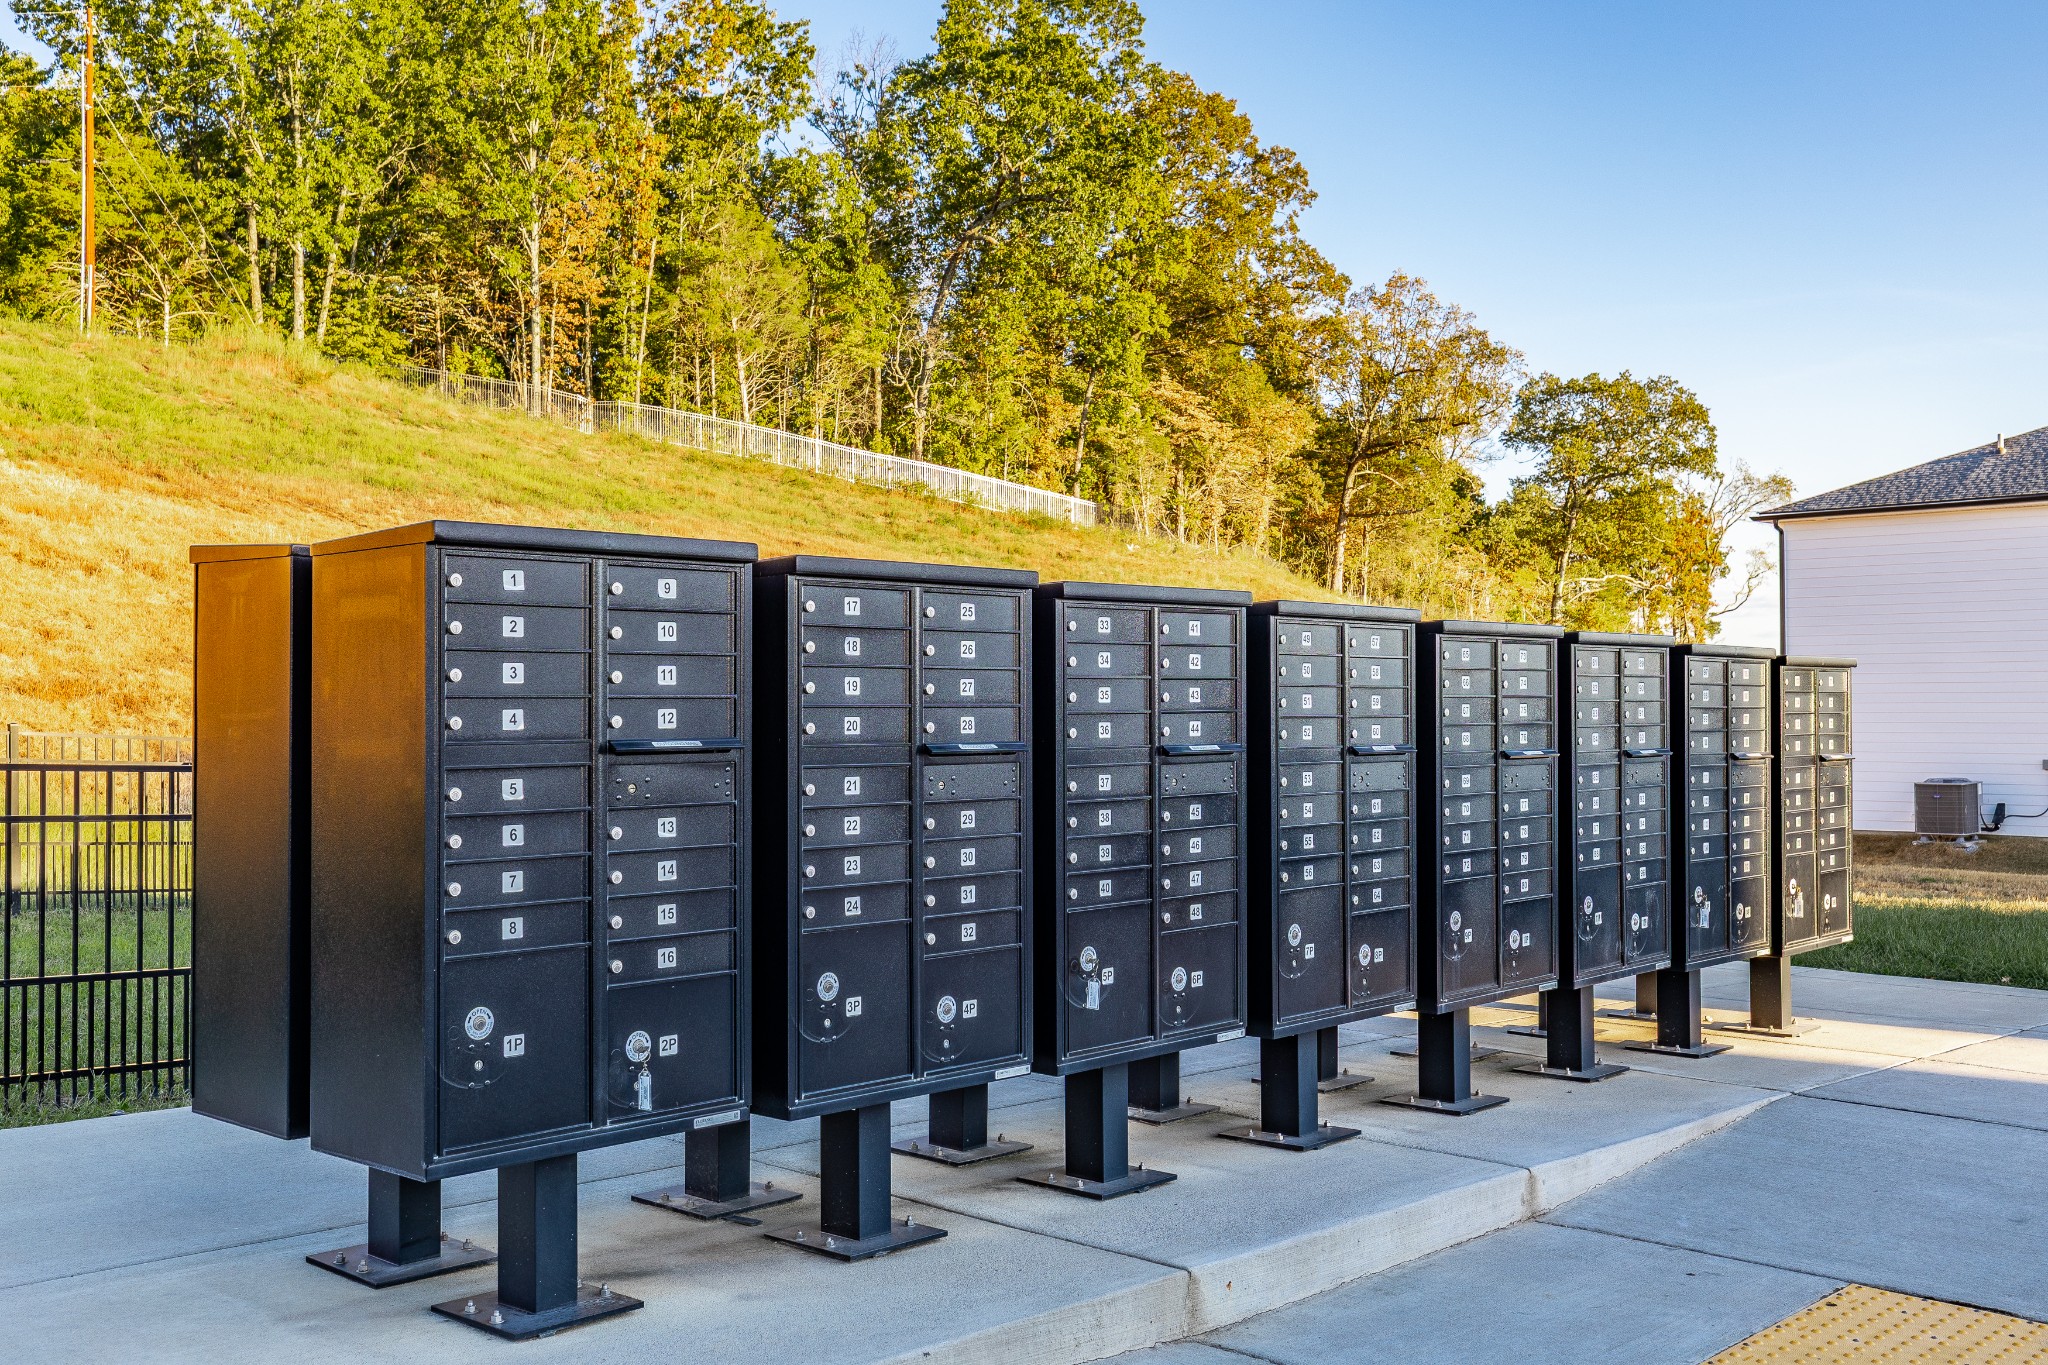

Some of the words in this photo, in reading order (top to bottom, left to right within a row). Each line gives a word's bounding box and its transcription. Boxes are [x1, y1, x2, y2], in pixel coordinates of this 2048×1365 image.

[511, 574, 516, 586] 1
[664, 582, 670, 594] 9
[847, 601, 858, 611] 17
[962, 606, 973, 617] 25
[510, 620, 517, 633] 2
[1100, 620, 1108, 630] 33
[1190, 624, 1198, 633] 41
[661, 625, 674, 637] 10
[1303, 634, 1310, 644] 49
[1371, 638, 1379, 647] 57
[847, 640, 857, 652] 18
[962, 644, 973, 655] 26
[1100, 655, 1109, 665] 34
[1191, 657, 1199, 667] 42
[510, 667, 517, 679] 3
[661, 669, 673, 681] 11
[1303, 665, 1310, 675] 50
[847, 680, 858, 692] 19
[962, 682, 972, 692] 27
[1100, 690, 1109, 700] 35
[1191, 690, 1199, 699] 43
[1303, 696, 1311, 706] 51
[1372, 698, 1380, 707] 59
[509, 713, 517, 725] 4
[661, 712, 674, 724] 12
[846, 720, 858, 731] 20
[962, 720, 973, 730] 28
[1100, 725, 1109, 735] 36
[1191, 724, 1199, 733] 44
[1303, 728, 1311, 737] 52
[1372, 727, 1380, 736] 60
[1100, 778, 1109, 788] 37
[1304, 774, 1311, 784] 53
[509, 783, 517, 795] 5
[846, 780, 856, 791] 21
[1304, 805, 1312, 815] 54
[1372, 801, 1380, 811] 61
[1191, 807, 1199, 816] 45
[962, 814, 973, 824] 29
[1100, 812, 1110, 823] 38
[661, 821, 674, 833] 13
[846, 820, 858, 831] 22
[510, 828, 517, 841] 6
[1191, 840, 1199, 850] 46
[1305, 836, 1313, 846] 55
[963, 851, 973, 863] 30
[1101, 848, 1110, 858] 39
[661, 864, 674, 876] 14
[846, 860, 858, 871] 23
[1305, 868, 1312, 878] 56
[509, 875, 516, 888] 7
[1191, 874, 1199, 883] 47
[1101, 883, 1110, 893] 40
[963, 889, 972, 900] 31
[1374, 890, 1381, 900] 64
[846, 900, 859, 912] 24
[661, 908, 674, 920] 15
[1191, 907, 1200, 916] 48
[509, 921, 517, 934] 8
[963, 927, 974, 938] 32
[1305, 946, 1314, 956] 7P
[661, 951, 674, 963] 16
[1103, 971, 1112, 981] 5P
[1192, 974, 1201, 984] 6P
[847, 1000, 860, 1012] 3P
[964, 1003, 975, 1014] 4P
[631, 1032, 645, 1040] OPEN
[507, 1038, 523, 1052] 1P
[662, 1038, 676, 1051] 2P
